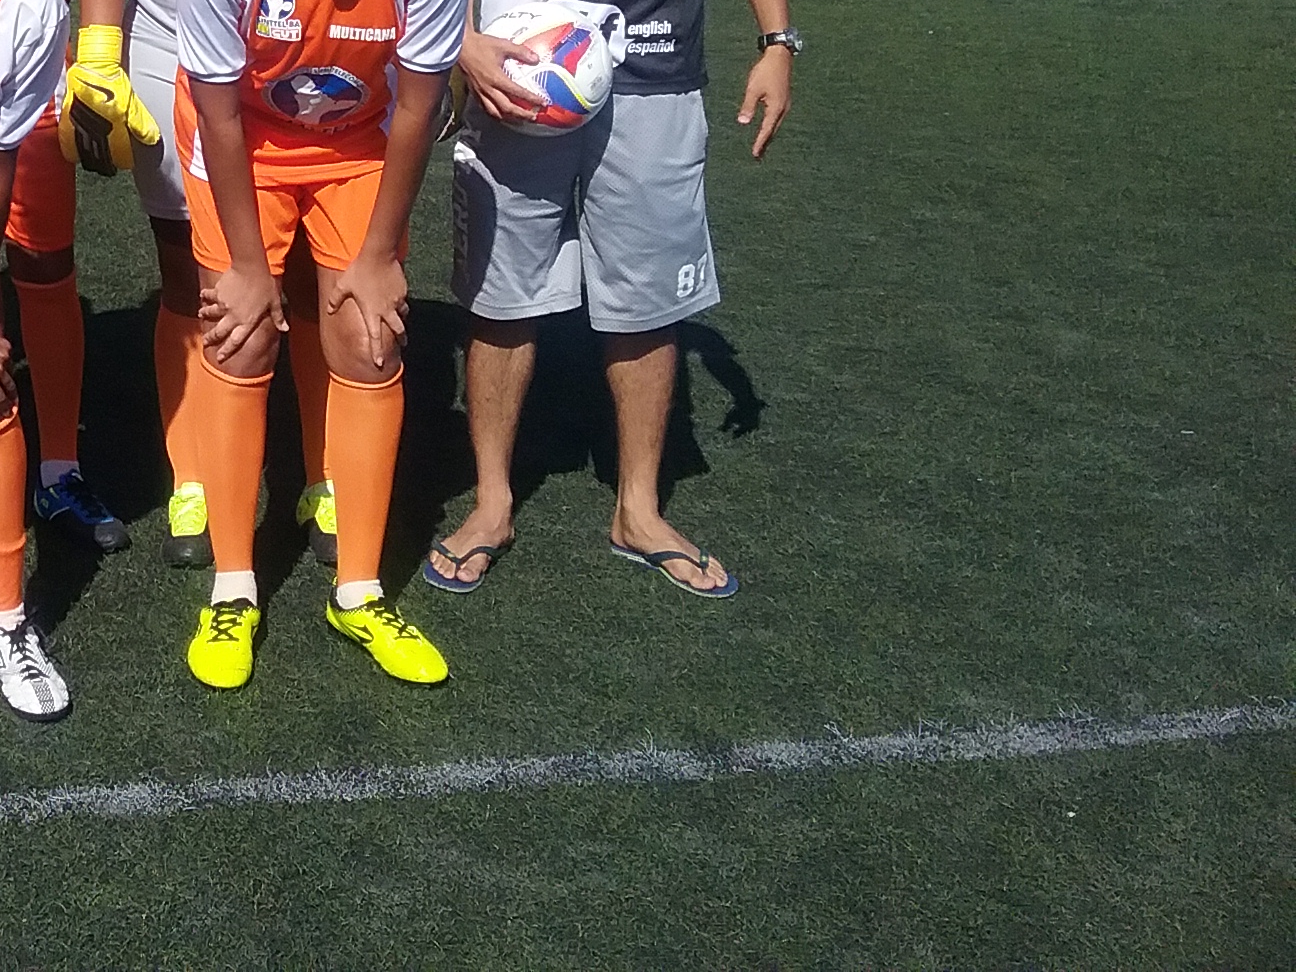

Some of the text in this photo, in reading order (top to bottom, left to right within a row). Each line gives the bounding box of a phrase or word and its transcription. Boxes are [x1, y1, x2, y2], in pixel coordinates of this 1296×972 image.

[628, 20, 672, 38] english
[628, 39, 676, 56] español
[676, 252, 708, 298] 87
